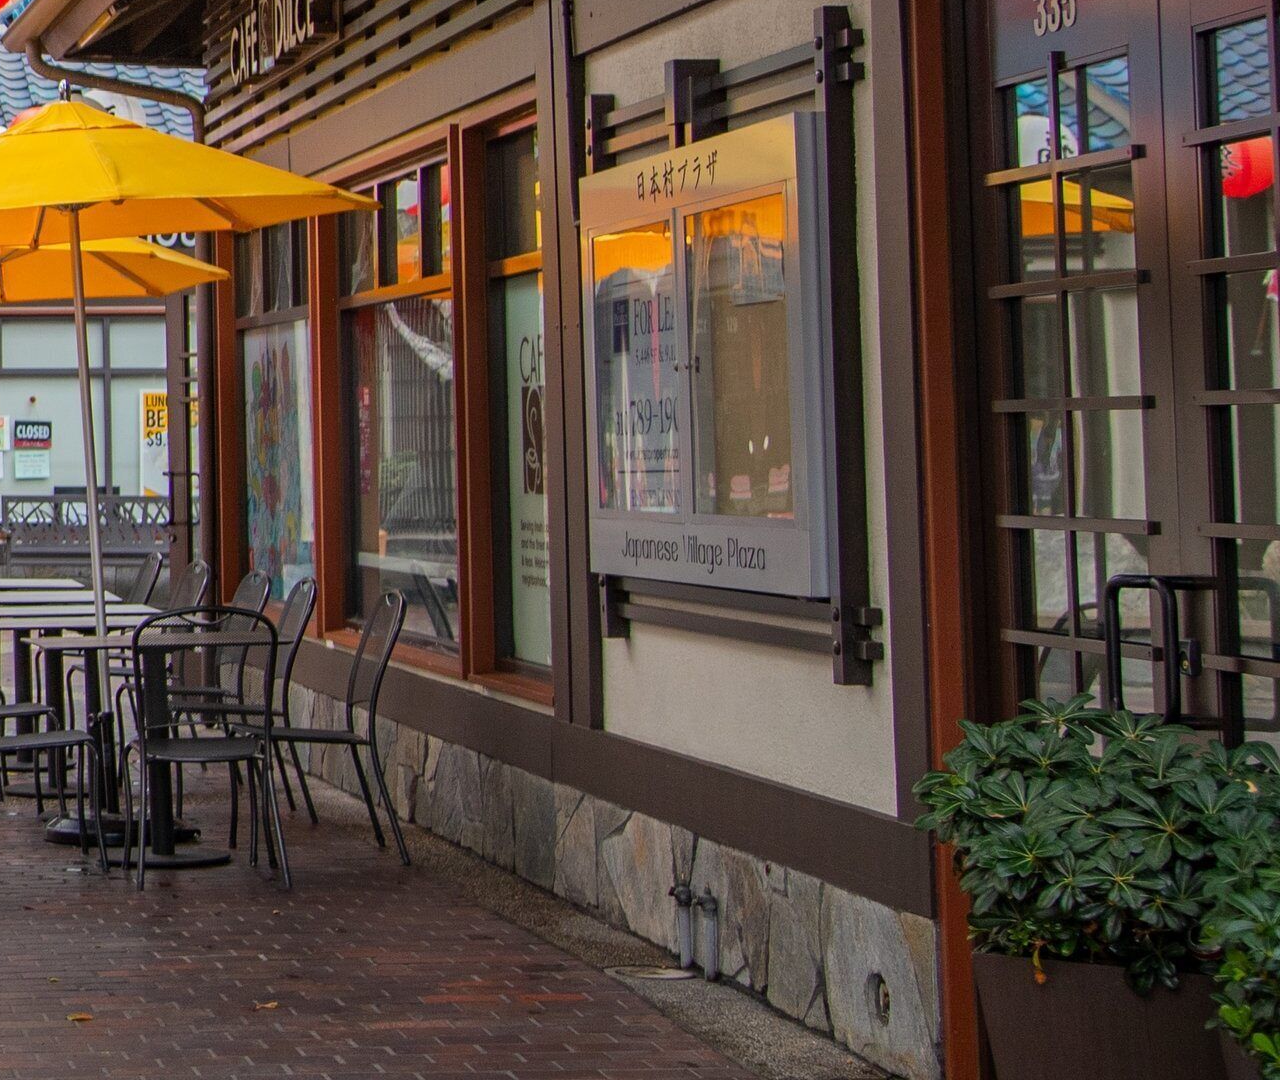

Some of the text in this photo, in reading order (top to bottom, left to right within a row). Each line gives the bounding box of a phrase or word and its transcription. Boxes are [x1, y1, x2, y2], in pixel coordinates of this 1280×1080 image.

[16, 424, 50, 440] CLOSED
[622, 531, 766, 574] Japanese Village Plaza
